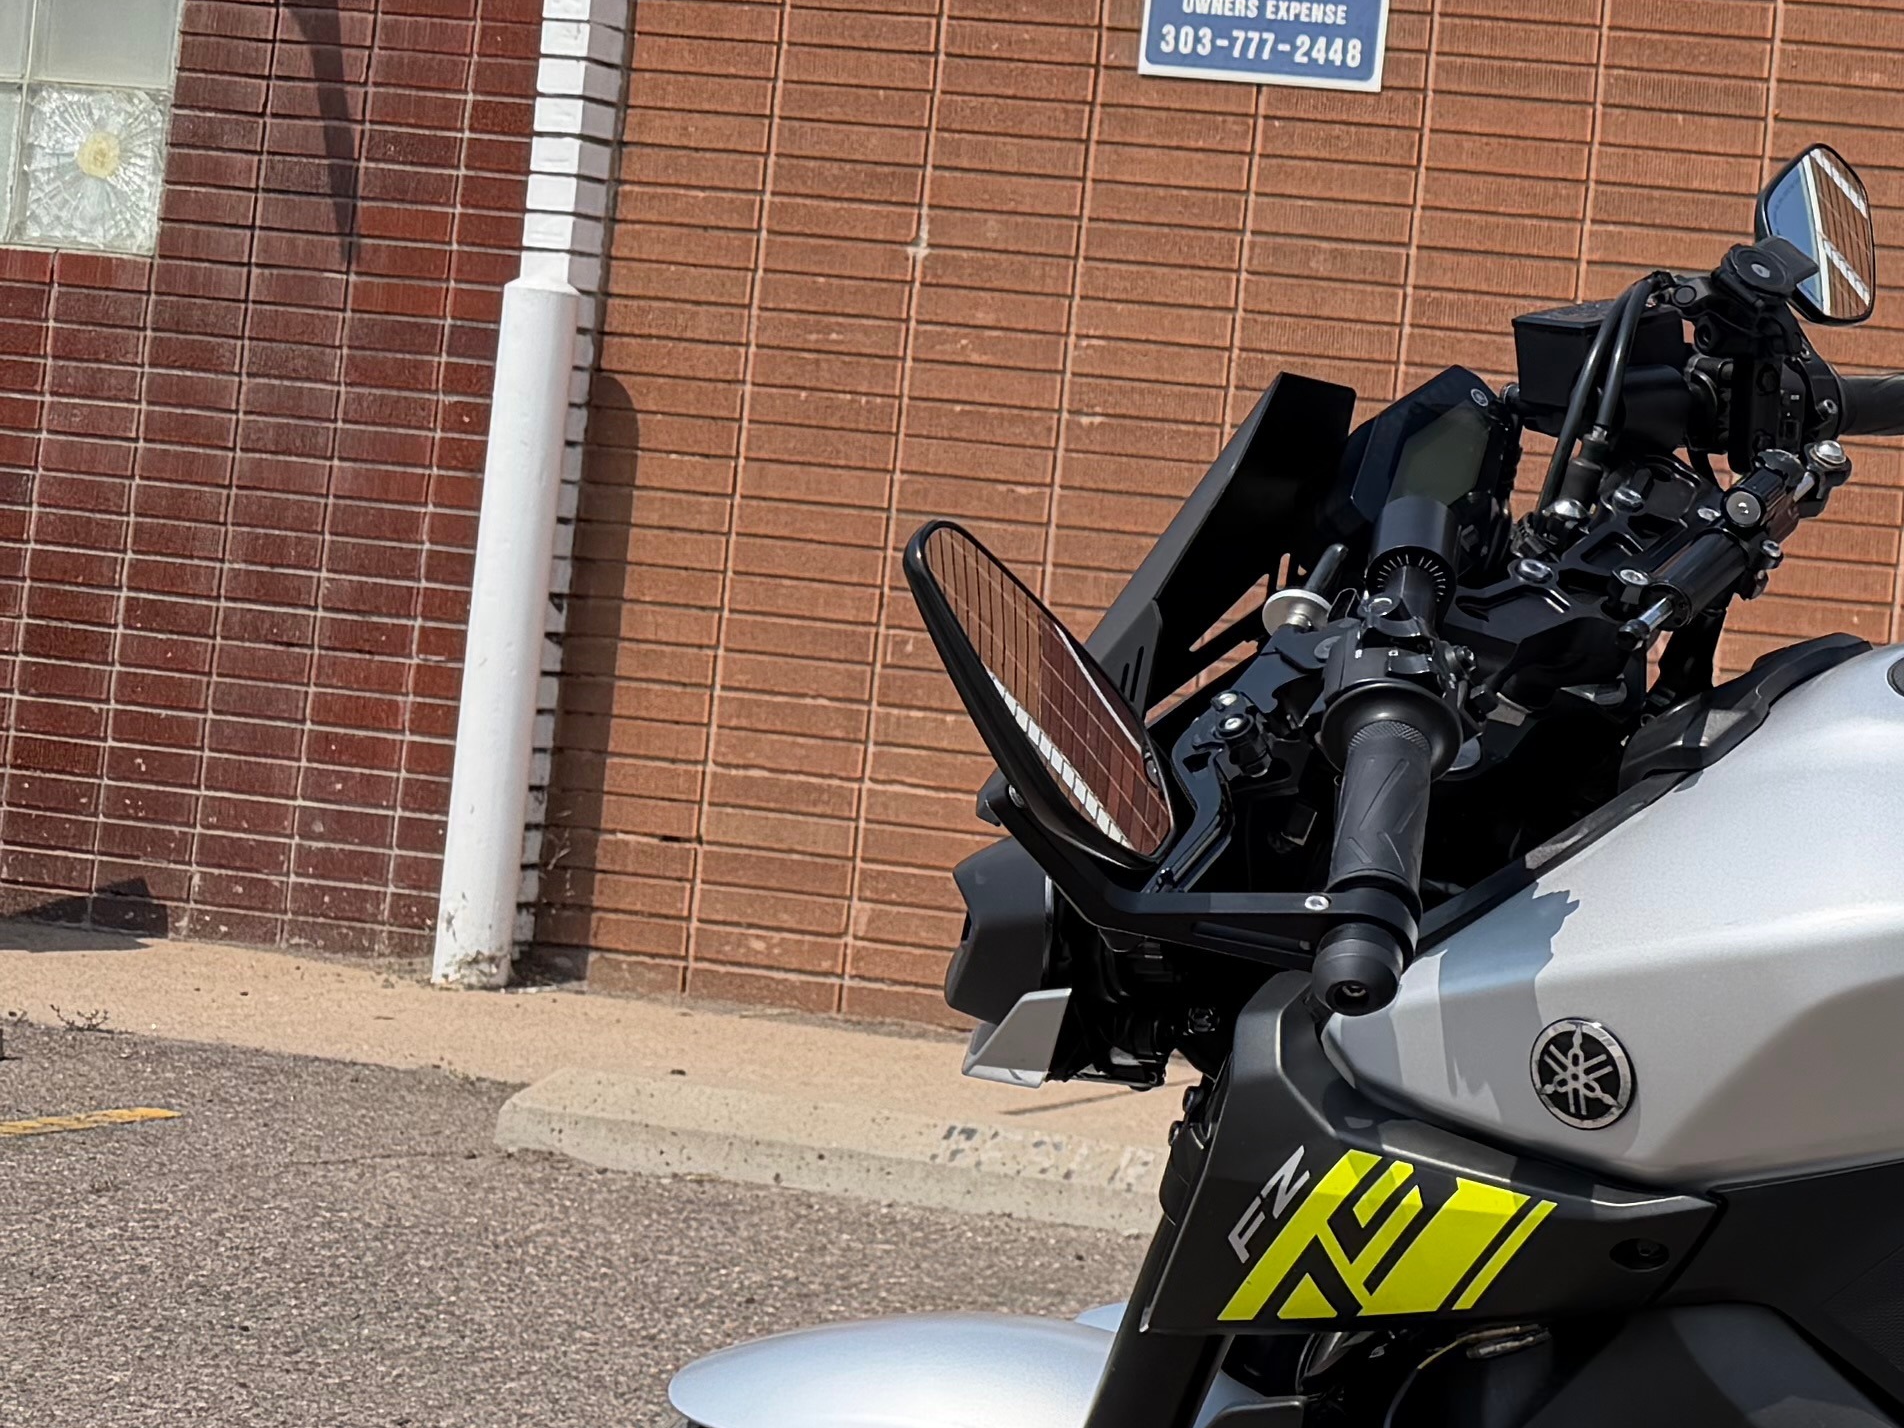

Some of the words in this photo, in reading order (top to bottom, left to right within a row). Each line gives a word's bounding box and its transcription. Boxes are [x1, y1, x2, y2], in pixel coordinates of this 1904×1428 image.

[1266, 2, 1347, 24] EXPENSE
[1160, 24, 1361, 68] 303-777-2448
[1228, 1145, 1311, 1264] FZ
